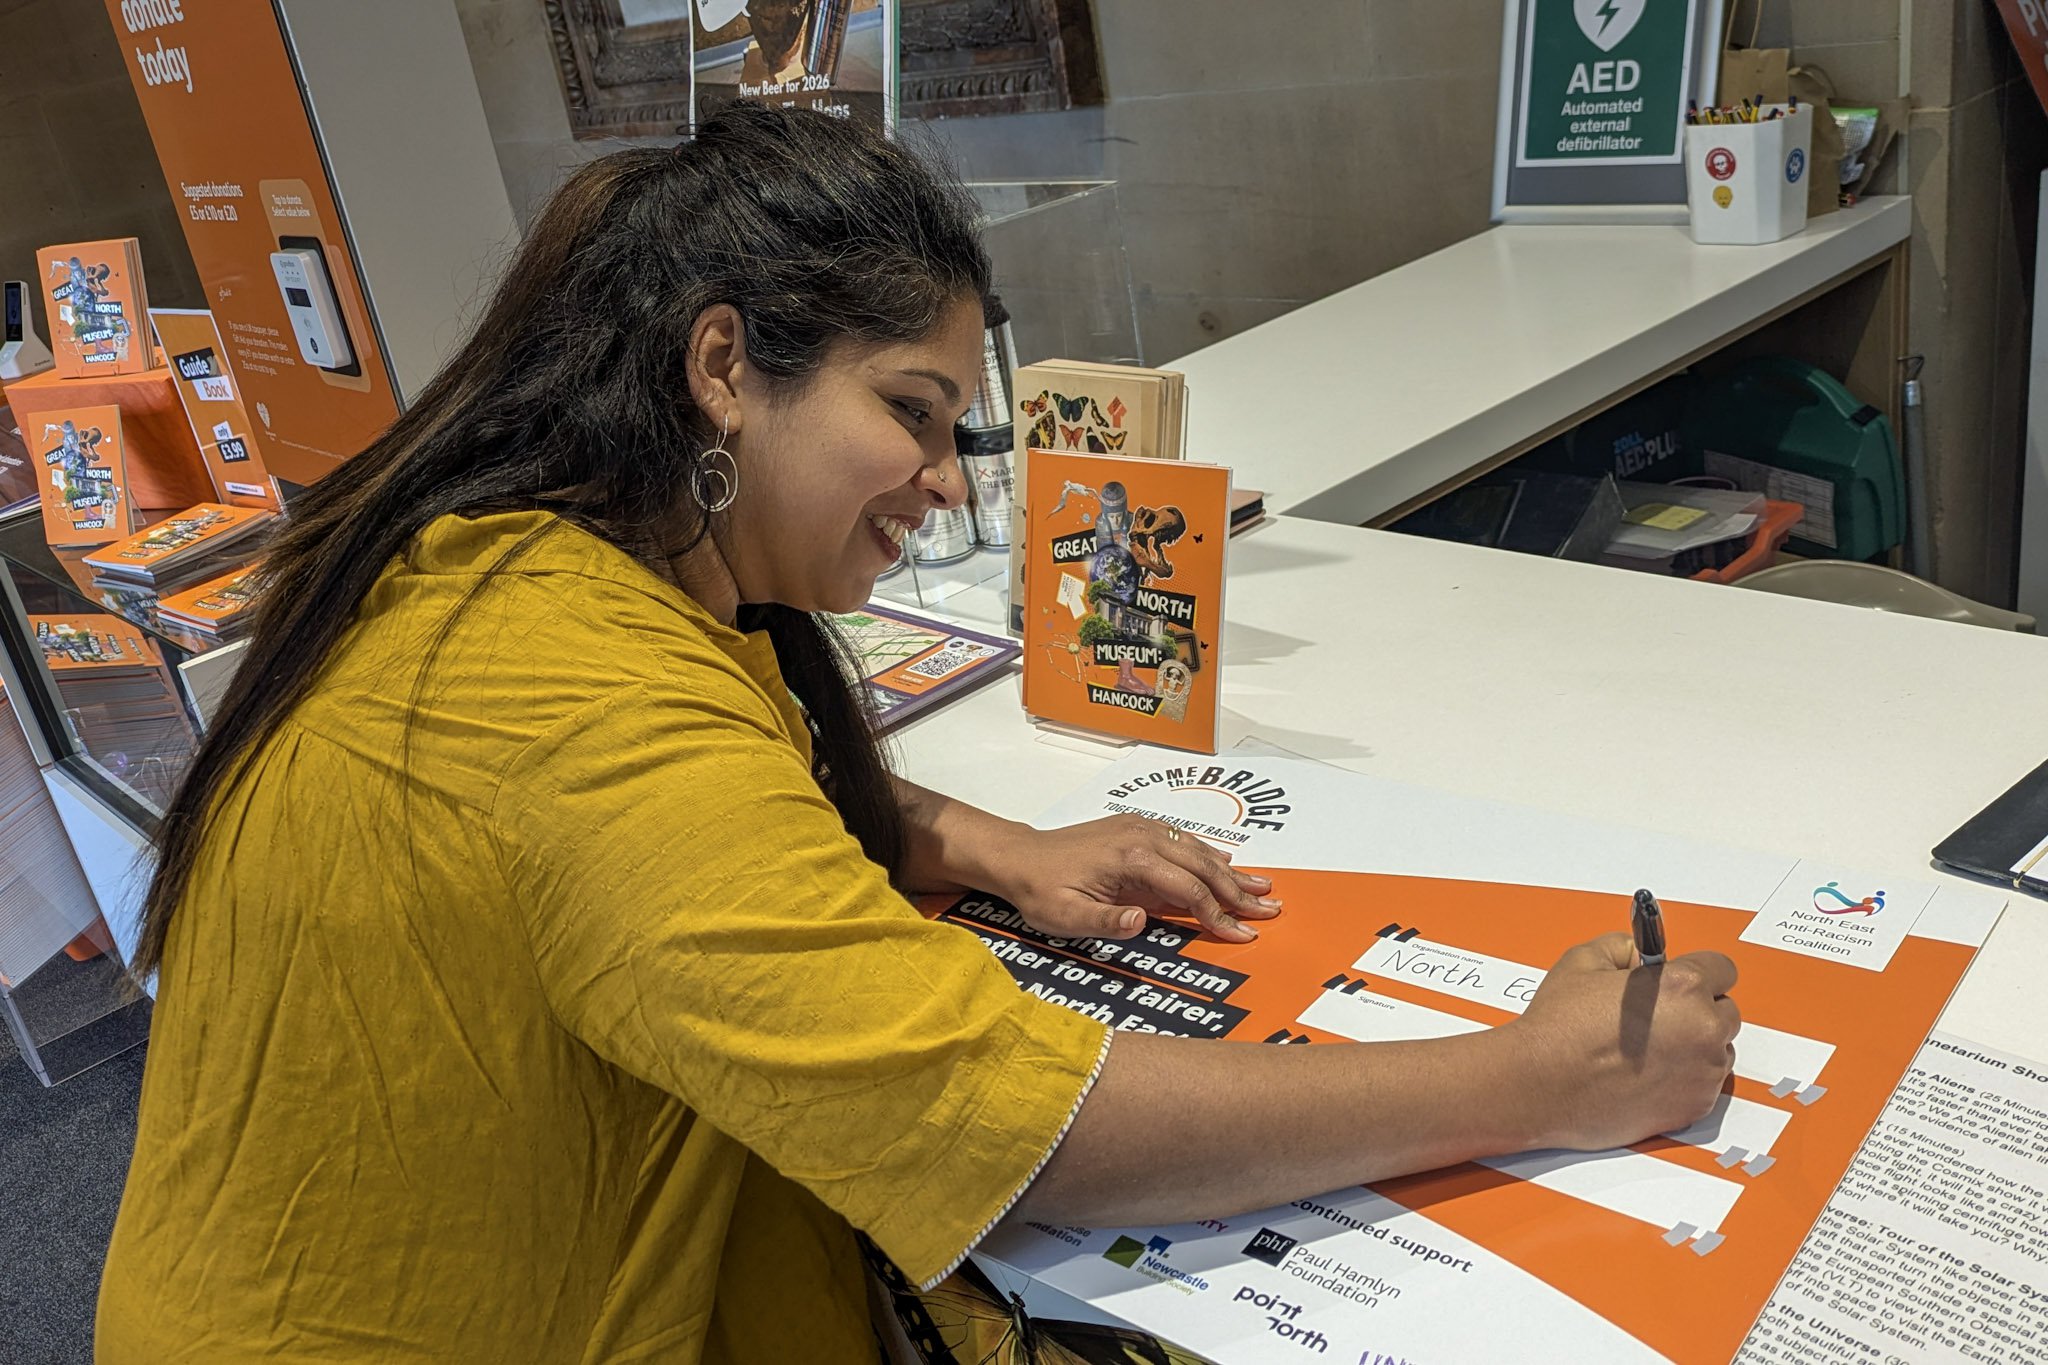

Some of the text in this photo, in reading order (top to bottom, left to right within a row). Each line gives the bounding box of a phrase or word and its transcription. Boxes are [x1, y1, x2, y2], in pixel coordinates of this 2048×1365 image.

[135, 36, 193, 93] today
[1566, 60, 1641, 95] AED
[739, 73, 830, 97] New Beer for 2026
[1561, 98, 1643, 117] Automated
[1570, 117, 1630, 133] external
[1557, 135, 1643, 152] defibrillator
[181, 181, 243, 201] Suggested donations
[53, 284, 74, 300] GREAT
[95, 302, 122, 314] NORTH
[85, 353, 116, 363] HANCOCK
[179, 356, 210, 378] Guide
[202, 380, 230, 398] Book
[217, 426, 230, 440] only
[46, 447, 66, 464] GREAT
[220, 441, 245, 460] £3.99
[86, 469, 112, 480] NORTH
[981, 480, 1000, 489] THE
[75, 521, 104, 529] HANCOCK
[1053, 537, 1098, 560] GREAT
[1136, 590, 1193, 620] NORTH
[1096, 643, 1163, 664] MUSEUM:
[1092, 688, 1154, 712] HANCOCK
[1107, 766, 1198, 799] BECOME
[1167, 778, 1194, 787] the
[1196, 766, 1291, 832] BRIDGE
[1103, 801, 1251, 844] TOGETHER AGAINST RACISM
[1146, 927, 1182, 948] to
[1776, 920, 1873, 947] Anti-Racism
[1790, 910, 1876, 934] North East
[1411, 942, 1484, 966] Organisation name
[1781, 934, 1852, 956] Coalition
[978, 935, 1224, 1032] ether for a fairer,
[1119, 949, 1230, 994] racism
[1380, 950, 1485, 988] North
[1358, 995, 1396, 1010] Signature
[1925, 1037, 2007, 1069] netarium
[1907, 1076, 1926, 1087] It's
[1929, 1085, 1958, 1097] now
[1971, 1100, 2009, 1116] small
[1928, 1074, 2001, 1102] Aliens (25
[1898, 1085, 2032, 1134] and faster than ever
[1928, 1104, 2028, 1145] We Are Aliens!
[1886, 1123, 1964, 1156] (15 Minutes)
[1918, 1114, 2032, 1159] evidence alien
[1883, 1134, 2043, 1197] ever wondered the
[1883, 1167, 1984, 1211] flight looks like
[1931, 1162, 2025, 1202] Cosmix show
[1855, 1181, 2009, 1245] where will take you?
[1890, 1183, 2024, 1239] spinning centrifuge
[2000, 1202, 2040, 1221] crazy
[1025, 1221, 1082, 1247] ndation
[1252, 1231, 1292, 1253] phf
[1290, 1199, 1474, 1274] continued support
[1845, 1225, 2016, 1301] Solar System like never
[1878, 1224, 1915, 1245] Tour
[1917, 1244, 1937, 1254] of
[1968, 1263, 2015, 1286] Solar
[1136, 1265, 1166, 1284] Building
[1142, 1255, 1209, 1292] Newcastle
[1281, 1259, 1379, 1309] Foundation
[1292, 1247, 1402, 1300] Paul Hamlyn
[1825, 1256, 1894, 1291] European
[1897, 1288, 1965, 1322] Southern
[1839, 1236, 2012, 1315] that can turn objects
[1792, 1256, 1985, 1346] ope (VLT) view the stars
[1803, 1274, 1928, 1335] into space visit
[1834, 1247, 2037, 1339] transported inside special
[1801, 1287, 1925, 1348] the Solar System.
[1774, 1334, 1827, 1362] subject
[1791, 1325, 1855, 1360] beautiful
[1808, 1318, 1880, 1356] Universe
